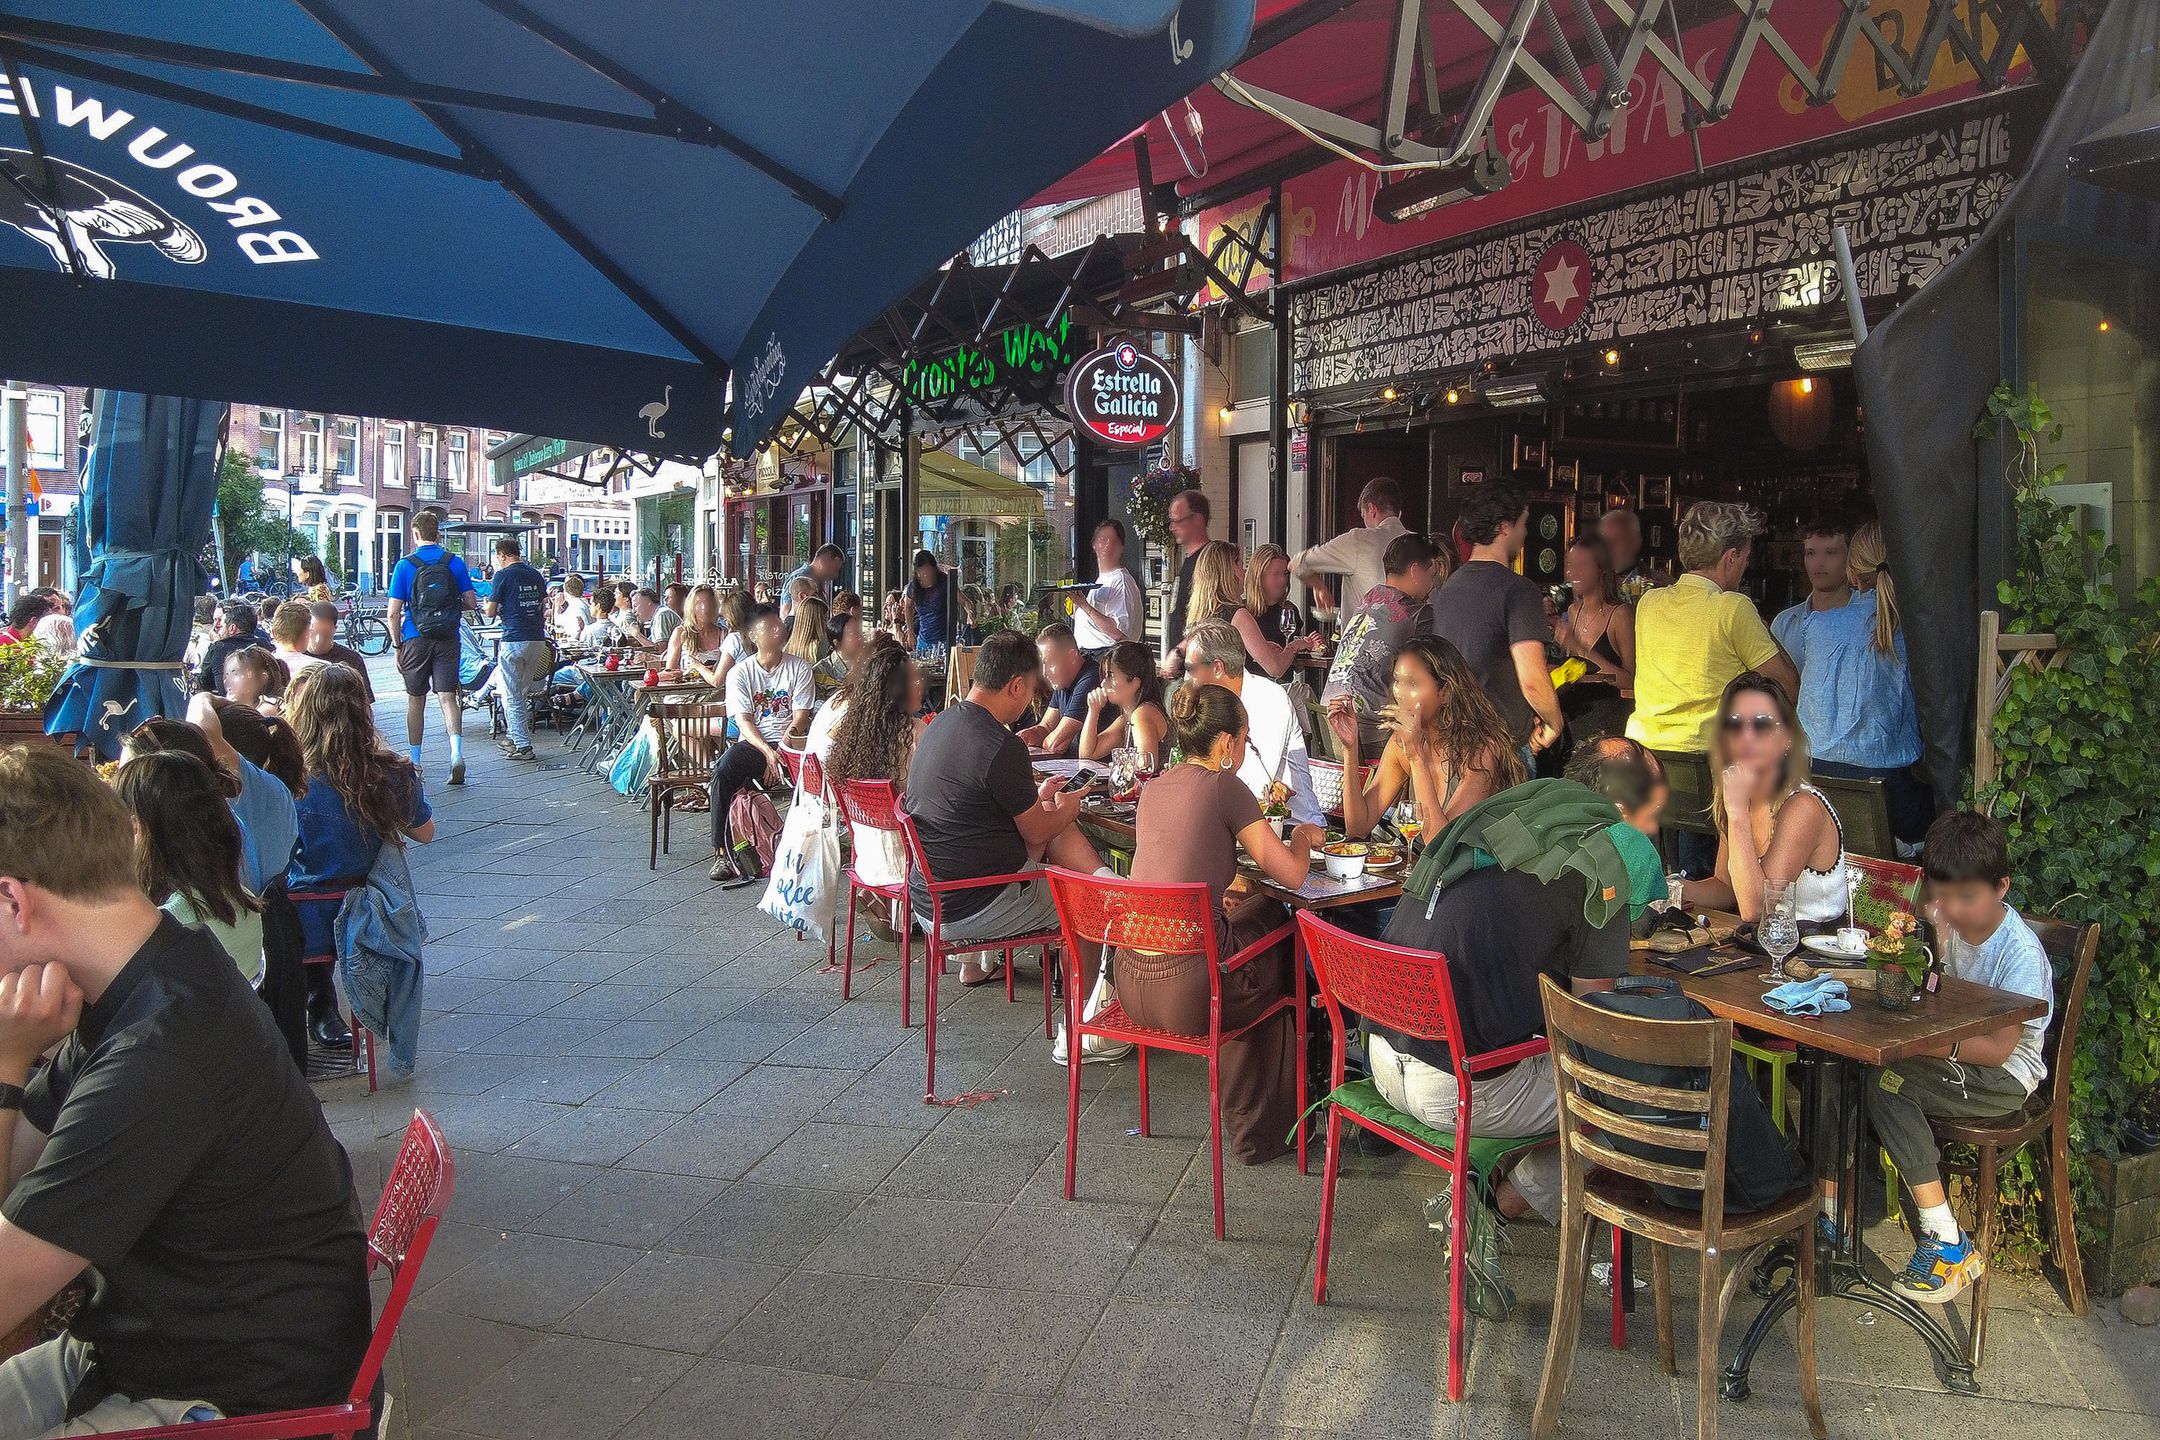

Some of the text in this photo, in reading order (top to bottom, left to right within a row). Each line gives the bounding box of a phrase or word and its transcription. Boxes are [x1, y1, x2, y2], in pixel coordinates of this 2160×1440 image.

[1528, 231, 1597, 282] ESTRELLA GALICIA
[1526, 296, 1566, 339] CERVECEROS
[1568, 306, 1592, 335] DESDE
[1092, 368, 1161, 395] Estrella
[1094, 391, 1159, 418] Galicia
[1107, 419, 1147, 437] Especial
